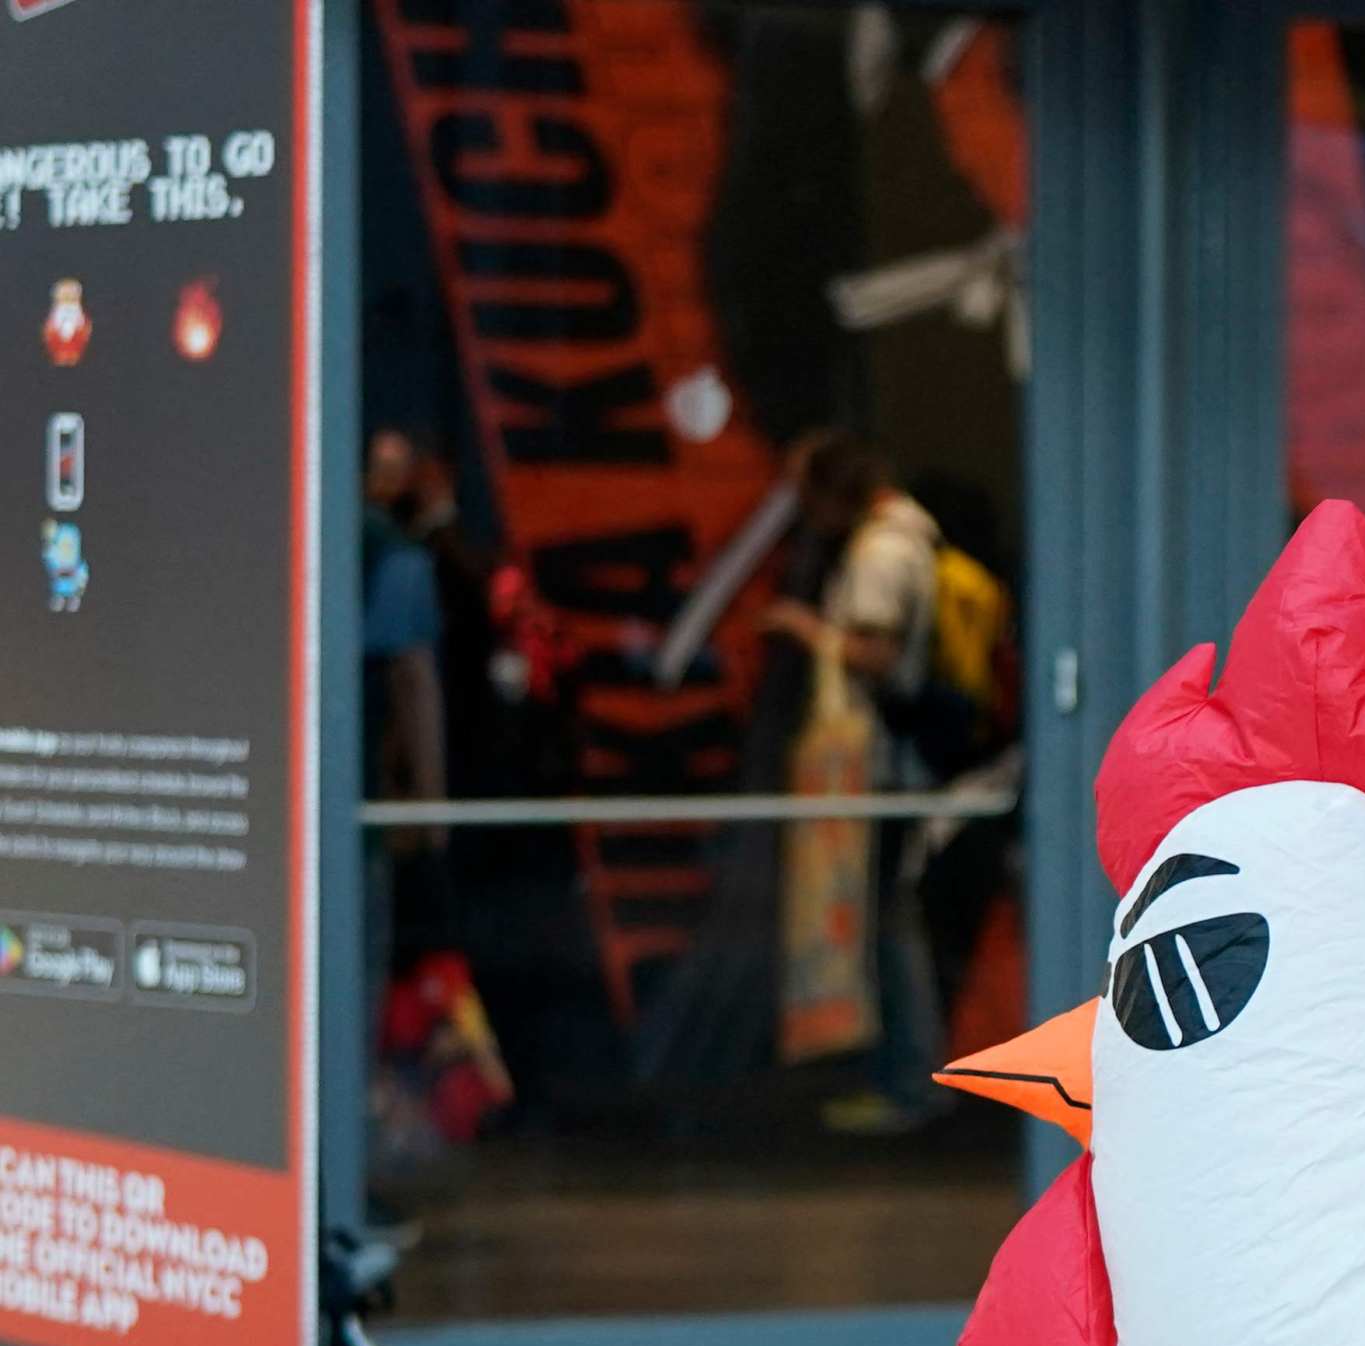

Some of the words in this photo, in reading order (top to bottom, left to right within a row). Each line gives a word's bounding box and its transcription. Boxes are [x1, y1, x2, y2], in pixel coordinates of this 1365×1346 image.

[164, 134, 211, 178] TO
[223, 130, 275, 178] GO
[48, 182, 133, 228] TAKE
[151, 173, 244, 223] THIS.
[57, 1156, 120, 1205] THIS
[57, 1201, 98, 1247] TO
[101, 1211, 269, 1283] DOWNLOAD
[0, 1266, 78, 1324] OBILE
[80, 1288, 139, 1336] APP
[33, 1235, 160, 1301] OFFICIAL
[160, 1262, 242, 1319] NYCC
